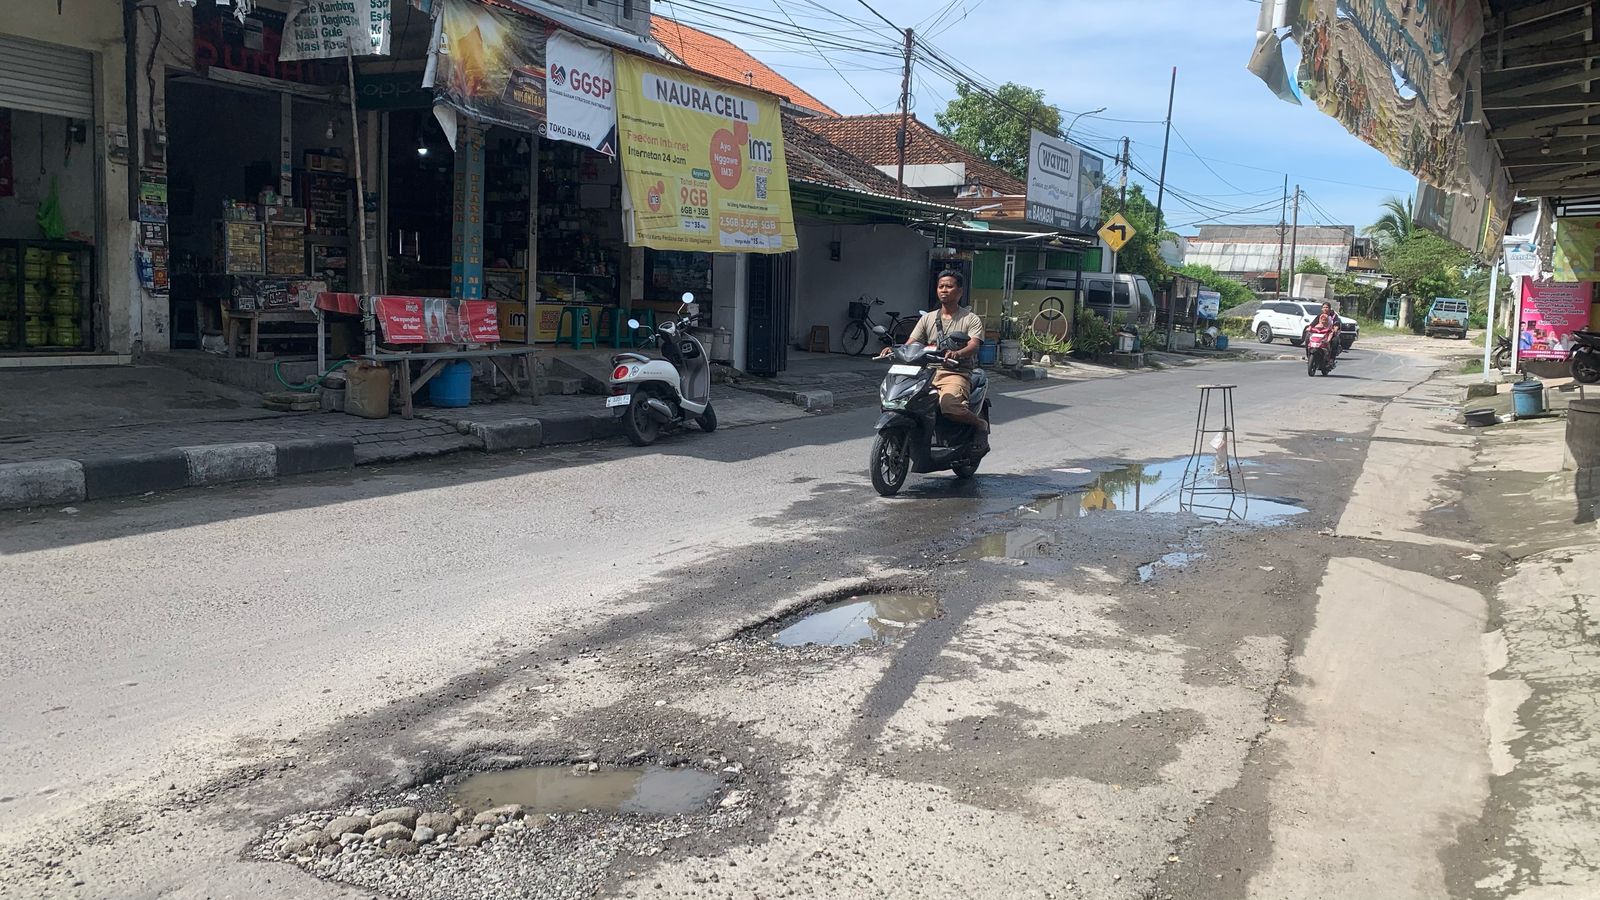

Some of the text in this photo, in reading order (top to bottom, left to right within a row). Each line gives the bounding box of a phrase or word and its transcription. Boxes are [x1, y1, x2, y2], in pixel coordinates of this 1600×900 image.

[321, 14, 351, 27] Daging
[295, 27, 343, 40] Nasi Gule
[296, 41, 320, 52] Nasi
[363, 82, 426, 98] opp
[570, 68, 612, 99] GGSP
[656, 78, 748, 121] NAURA CELL
[549, 122, 566, 135] TOKO
[567, 128, 577, 137] BU
[577, 130, 591, 141] KHA
[720, 142, 732, 152] Ayo
[748, 133, 772, 162] im3
[628, 145, 686, 166] Internetan 24 Jam
[714, 153, 738, 165] Nggawe
[1042, 149, 1069, 174] wavin
[680, 186, 708, 208] 9GB
[681, 206, 692, 215] 6GB
[698, 207, 709, 216] 3GB
[509, 310, 527, 326] im
